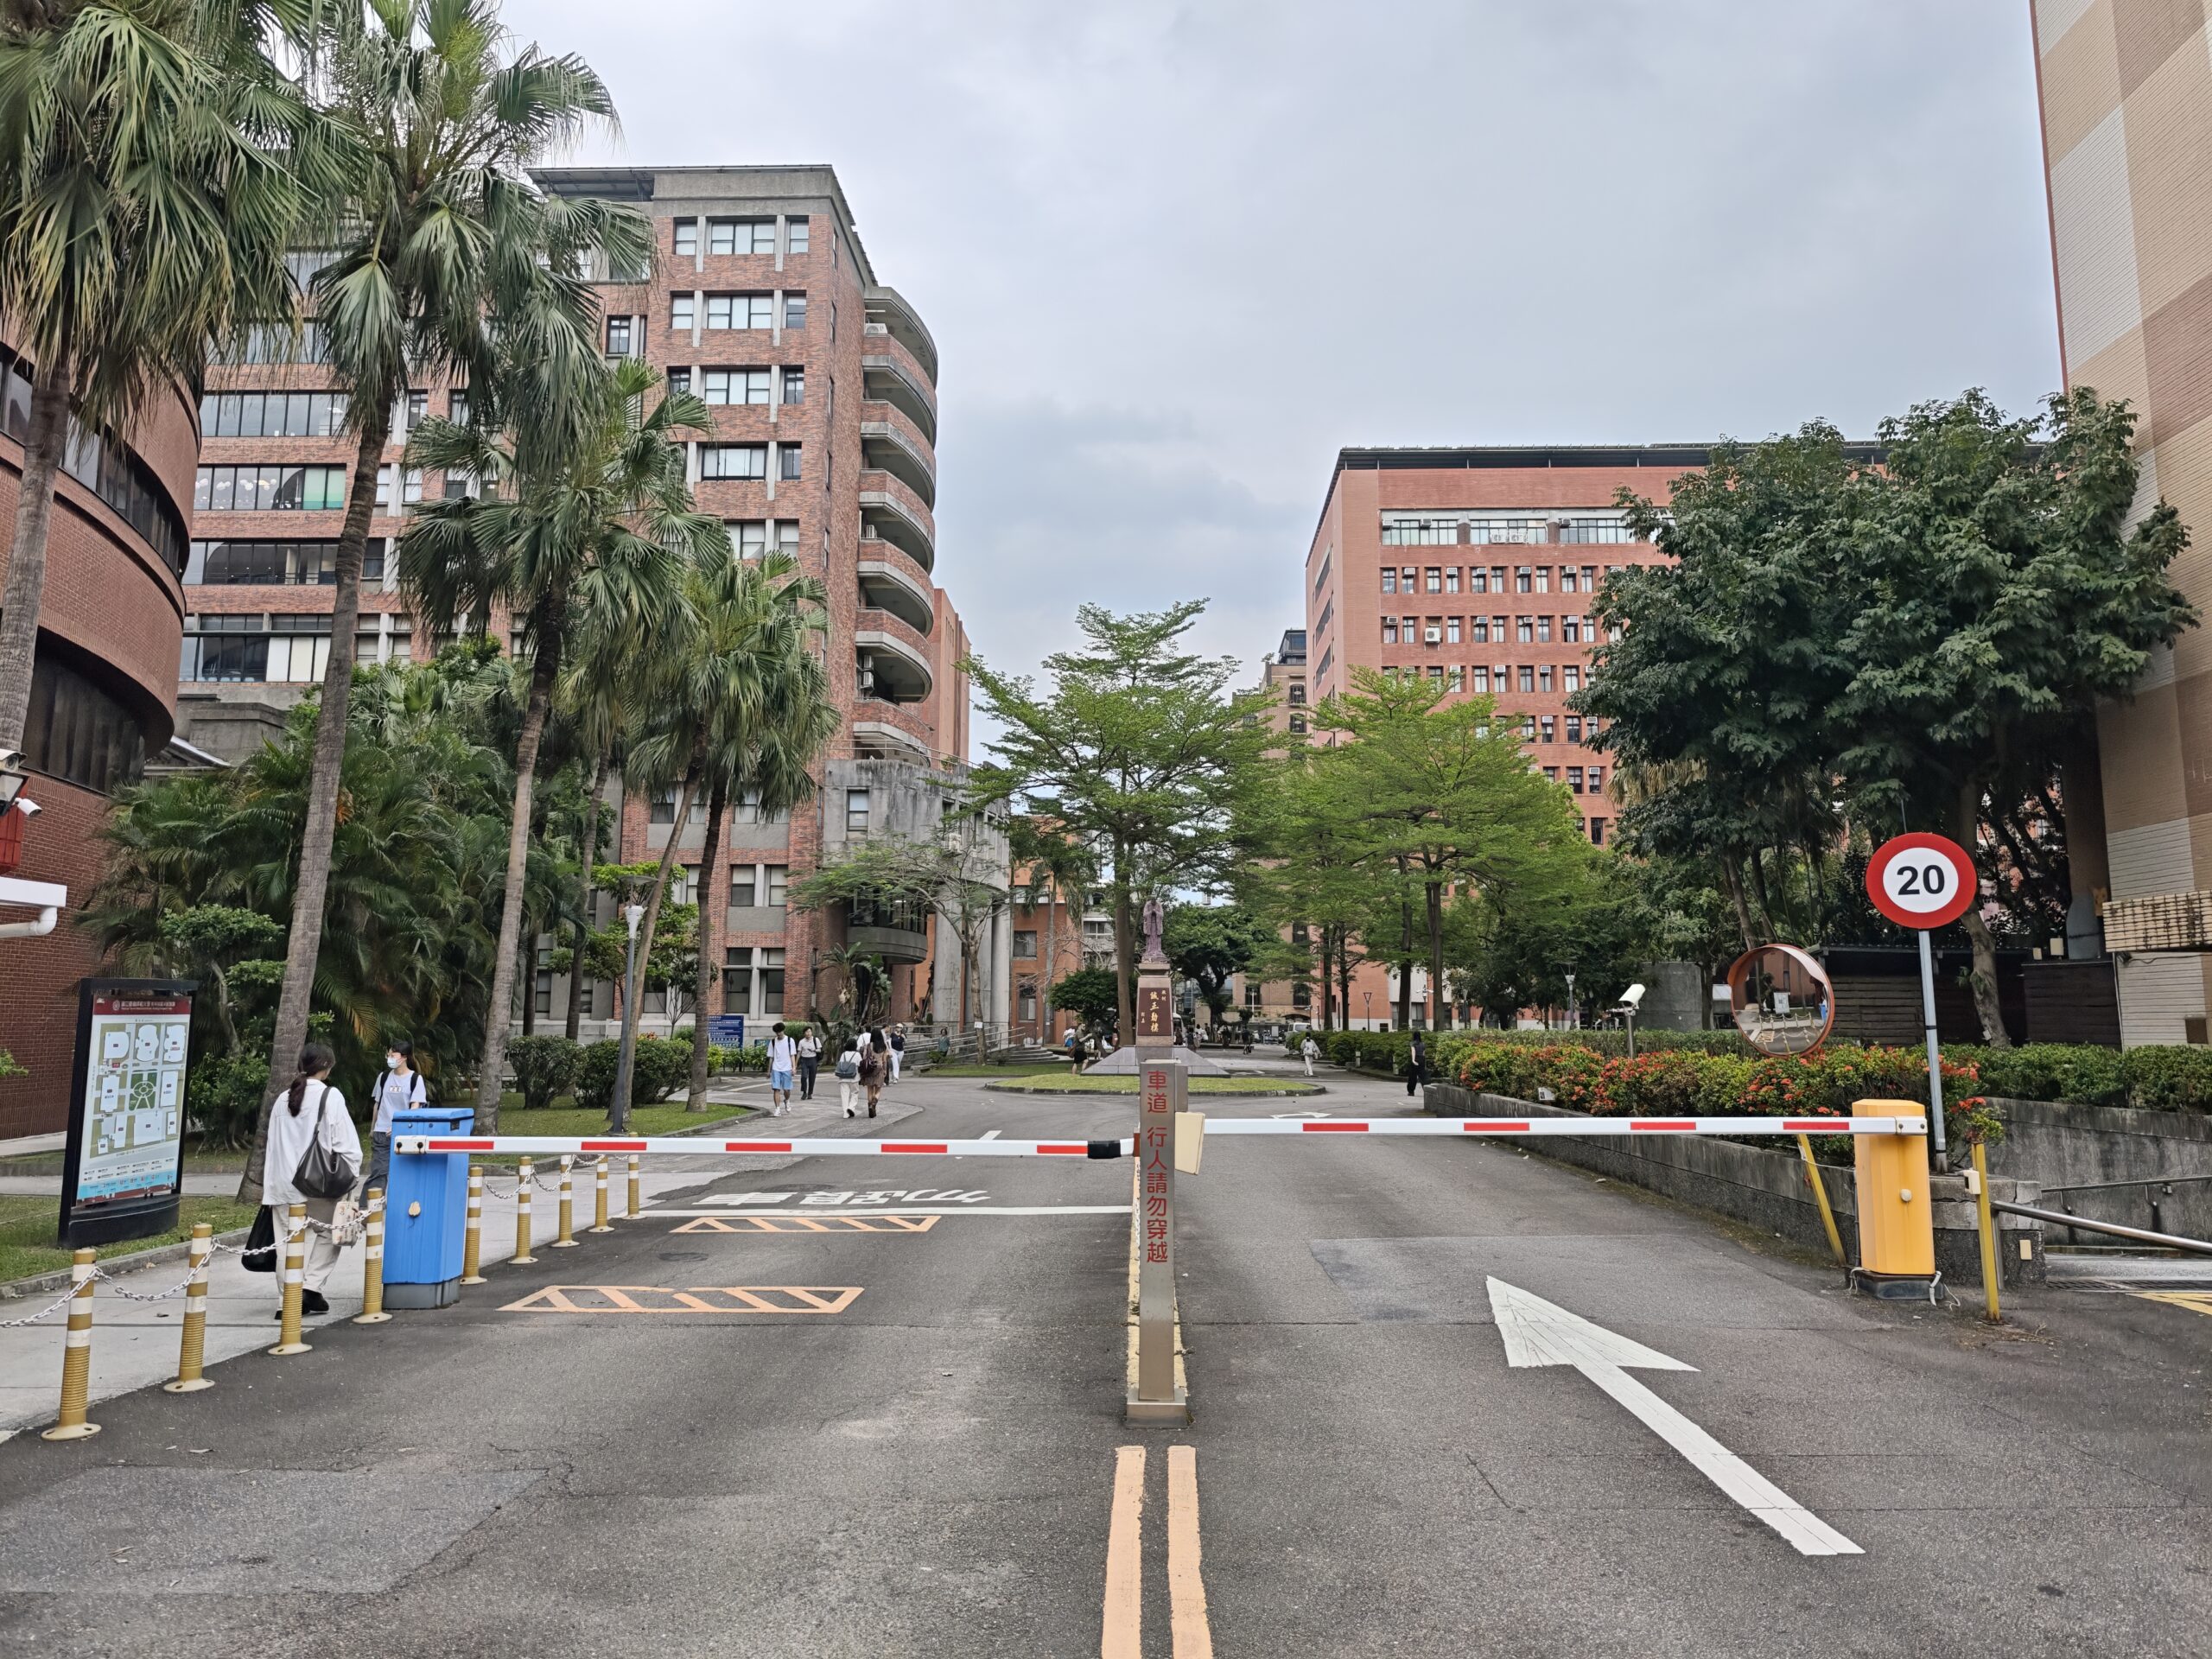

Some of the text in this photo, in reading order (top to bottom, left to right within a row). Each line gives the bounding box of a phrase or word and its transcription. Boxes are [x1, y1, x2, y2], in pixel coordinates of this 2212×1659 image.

[1897, 864, 1945, 896] 20
[1147, 1071, 1168, 1263] 車道 行人請勿穿越
[690, 1188, 991, 1206] 勿跟車
